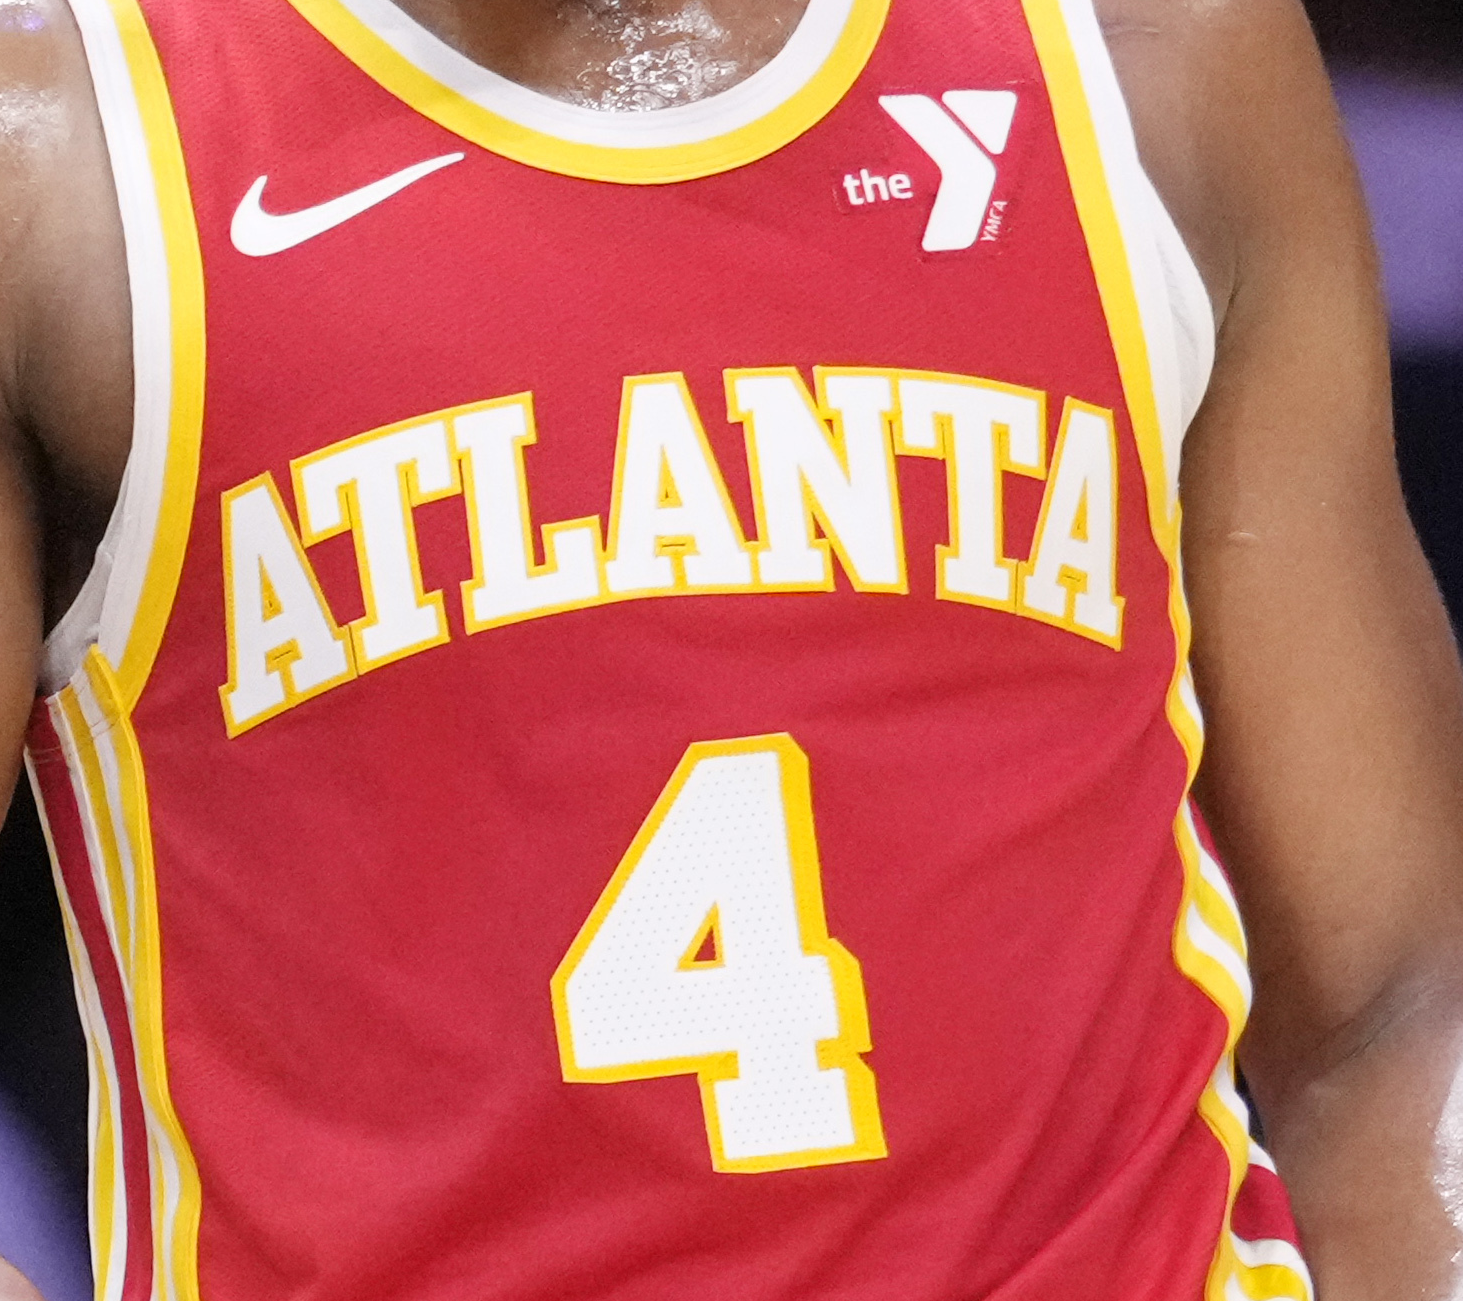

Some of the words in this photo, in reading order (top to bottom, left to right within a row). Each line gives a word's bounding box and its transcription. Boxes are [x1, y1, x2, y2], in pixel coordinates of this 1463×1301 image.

[842, 168, 914, 206] the
[219, 364, 1124, 739] ATLANTA
[550, 731, 889, 1174] 4
